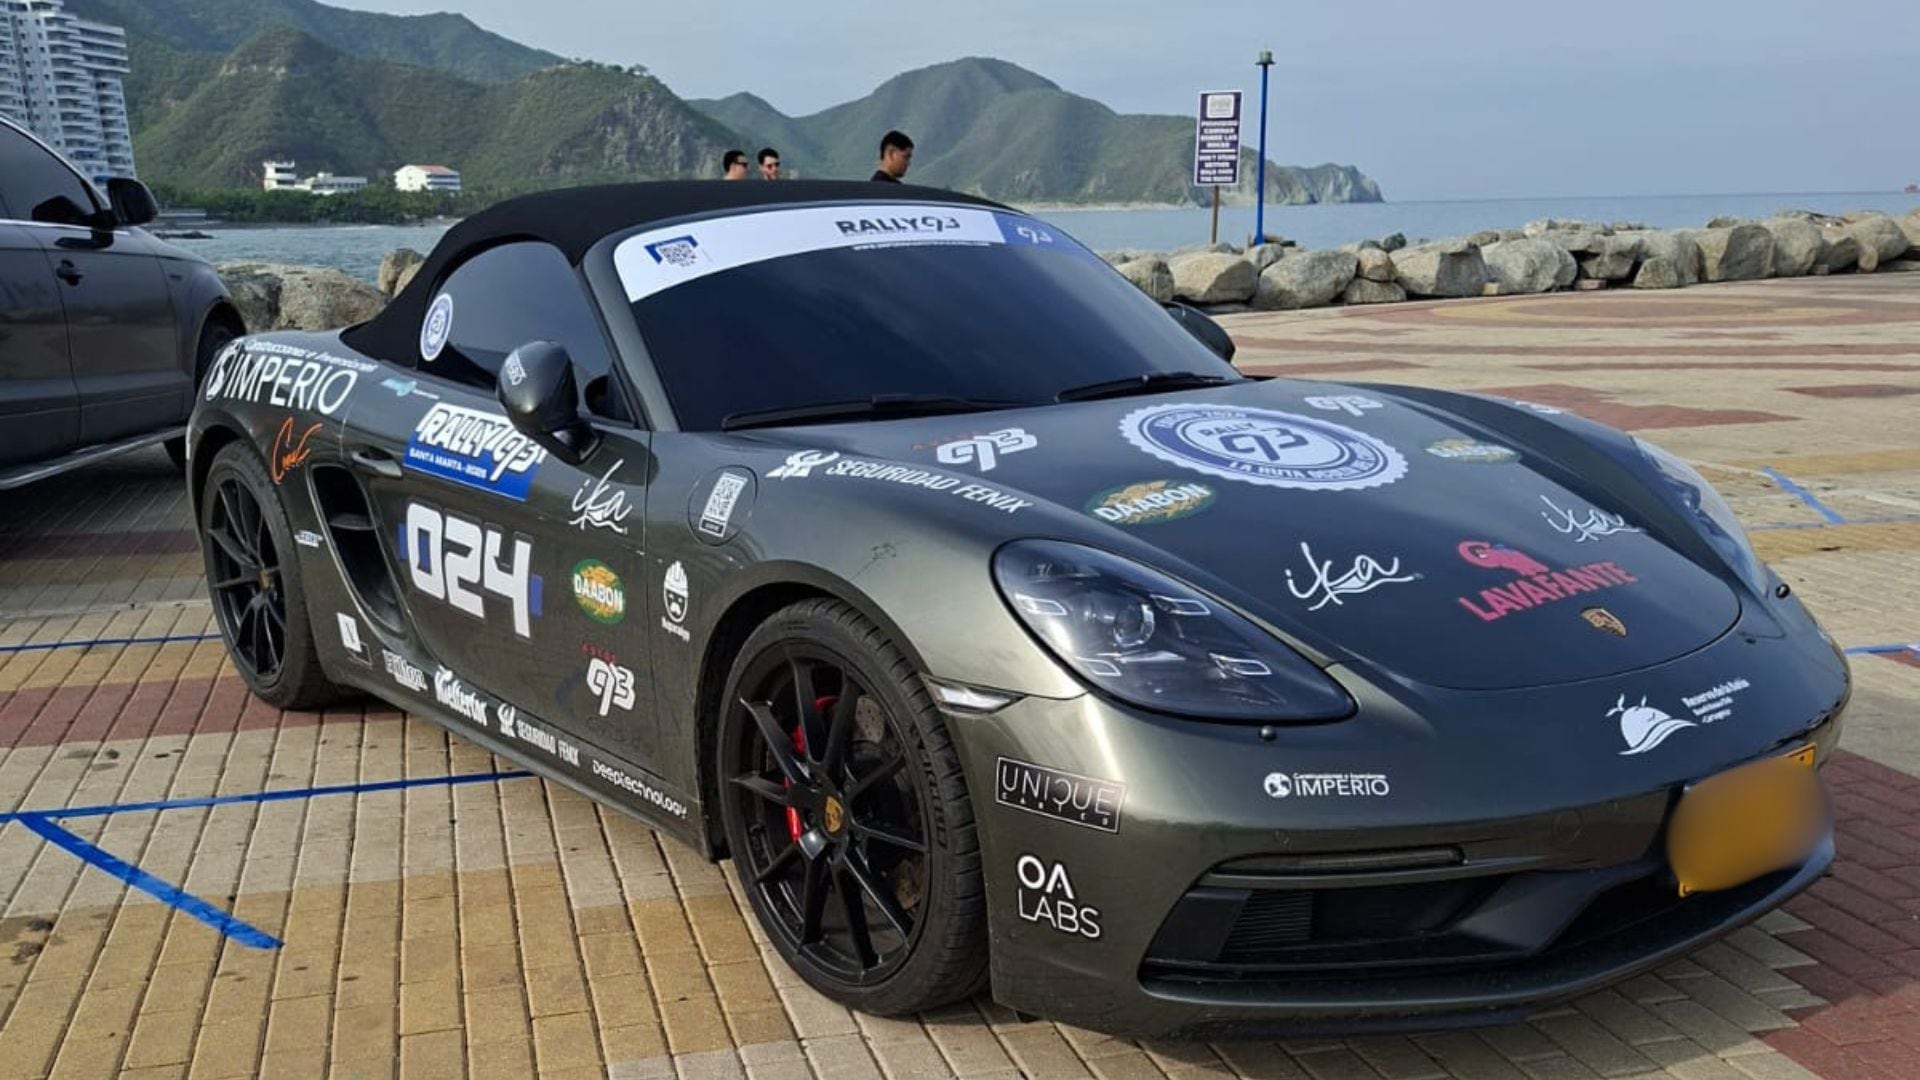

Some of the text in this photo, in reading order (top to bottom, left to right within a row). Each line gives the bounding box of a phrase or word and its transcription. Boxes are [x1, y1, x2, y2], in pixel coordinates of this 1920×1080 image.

[223, 353, 358, 415] IMPERIO
[936, 427, 1038, 472] 93
[1197, 422, 1255, 436] RALLY
[1218, 427, 1309, 462] 93
[826, 459, 1035, 514] SEGURIDAD FENIX
[1093, 483, 1212, 521] DAABON
[405, 501, 533, 640] 024
[573, 573, 624, 613] DAABON
[1458, 561, 1640, 623] LAVAFANTE
[586, 657, 636, 717] 93
[1002, 764, 1116, 816] UNIQUE
[1294, 779, 1390, 796] IMPERIO
[1017, 855, 1074, 899] OA
[1018, 888, 1100, 938] LABS
